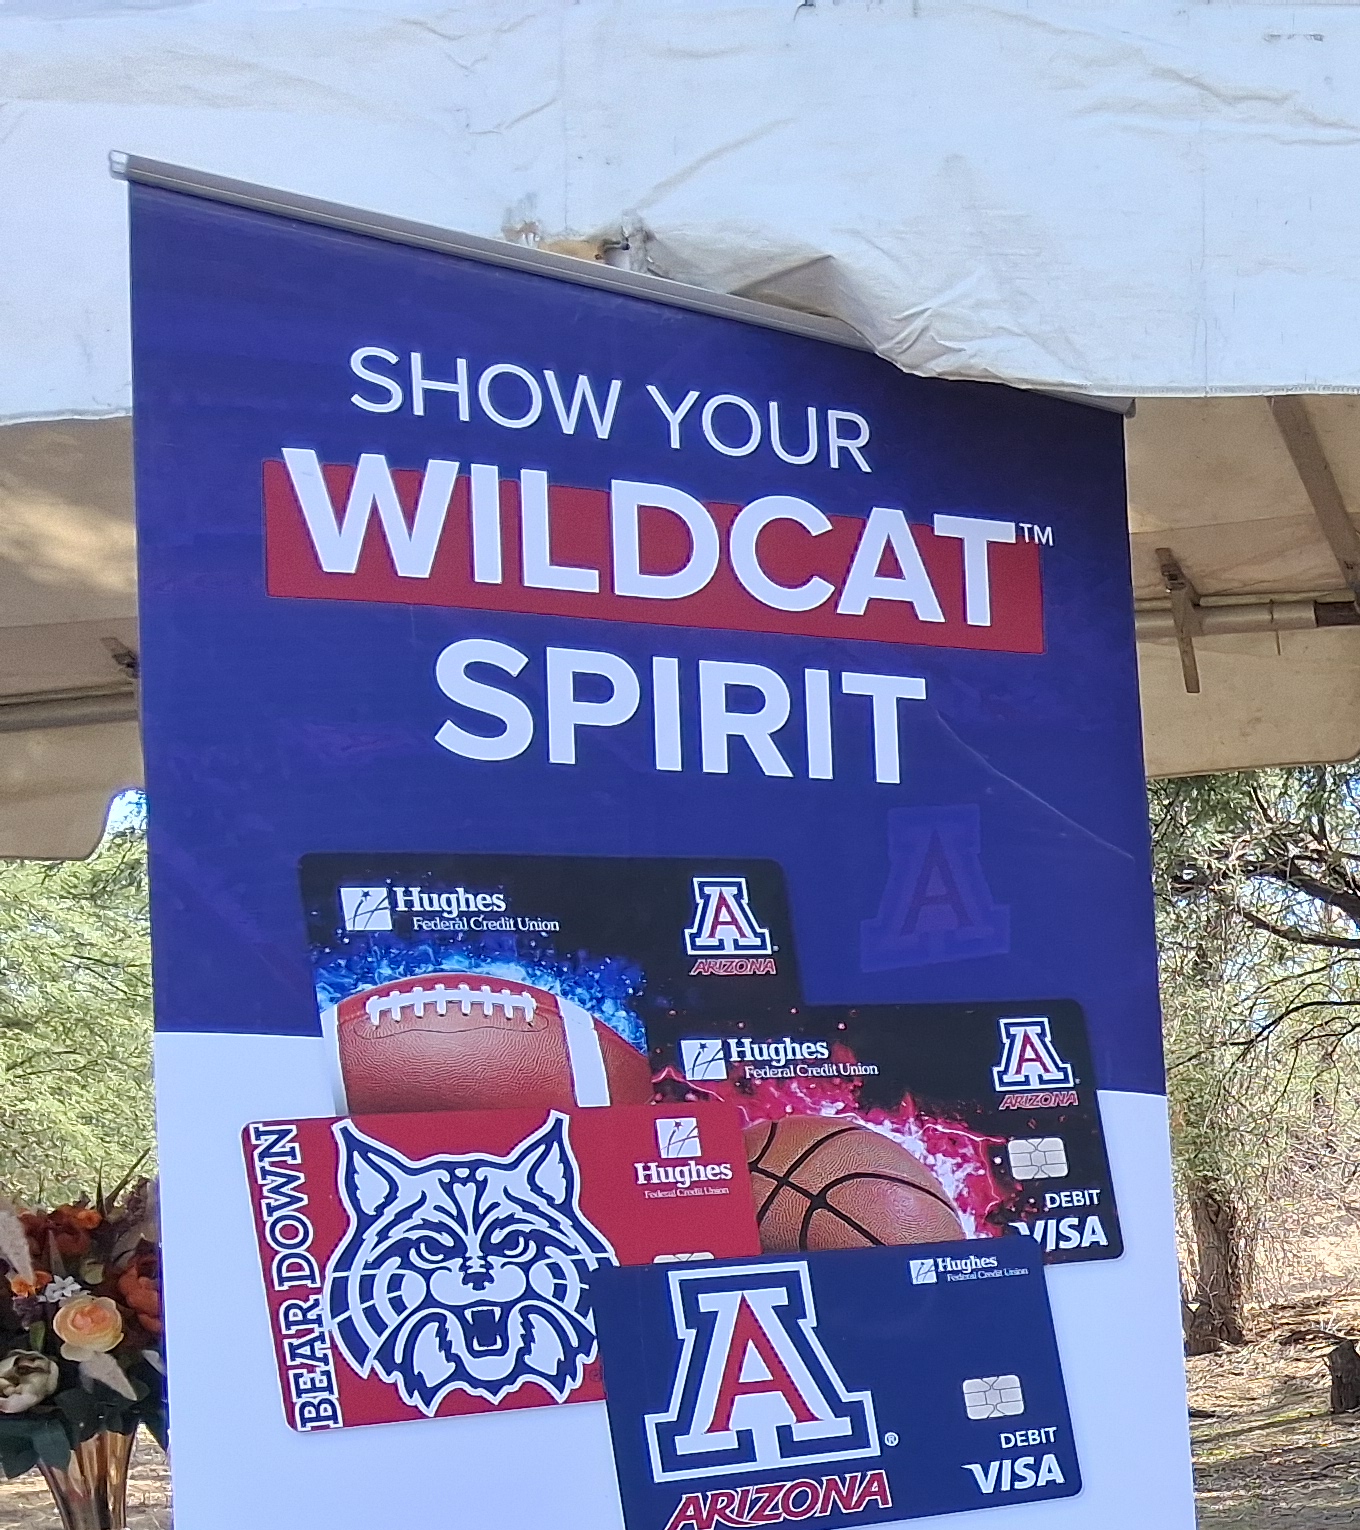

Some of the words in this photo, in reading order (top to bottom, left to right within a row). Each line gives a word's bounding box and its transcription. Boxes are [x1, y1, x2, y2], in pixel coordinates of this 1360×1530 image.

[349, 346, 621, 440] SHOW
[646, 382, 871, 474] YOUR
[434, 638, 926, 785] SPIRIT
[392, 887, 506, 918] Hughes
[684, 877, 773, 956] A
[413, 917, 468, 930] Federal
[470, 917, 516, 931] Credit
[518, 917, 560, 931] Union
[689, 958, 777, 975] ARIZONA
[727, 1038, 829, 1066] Hughes
[992, 1017, 1075, 1092] A
[745, 1064, 795, 1079] Federal
[797, 1063, 839, 1078] Credit
[841, 1063, 879, 1076] Union
[999, 1091, 1078, 1110] ARIZONA
[634, 1161, 732, 1188] Hughes
[252, 1123, 323, 1290] DOWN
[1046, 1190, 1101, 1209] DEBIT
[1008, 1217, 1108, 1251] VISA
[937, 1255, 997, 1273] Hughes
[281, 1298, 342, 1431] BEAR
[644, 1261, 881, 1483] A
[1000, 1427, 1057, 1449] DEBIT
[961, 1453, 1064, 1494] VISA
